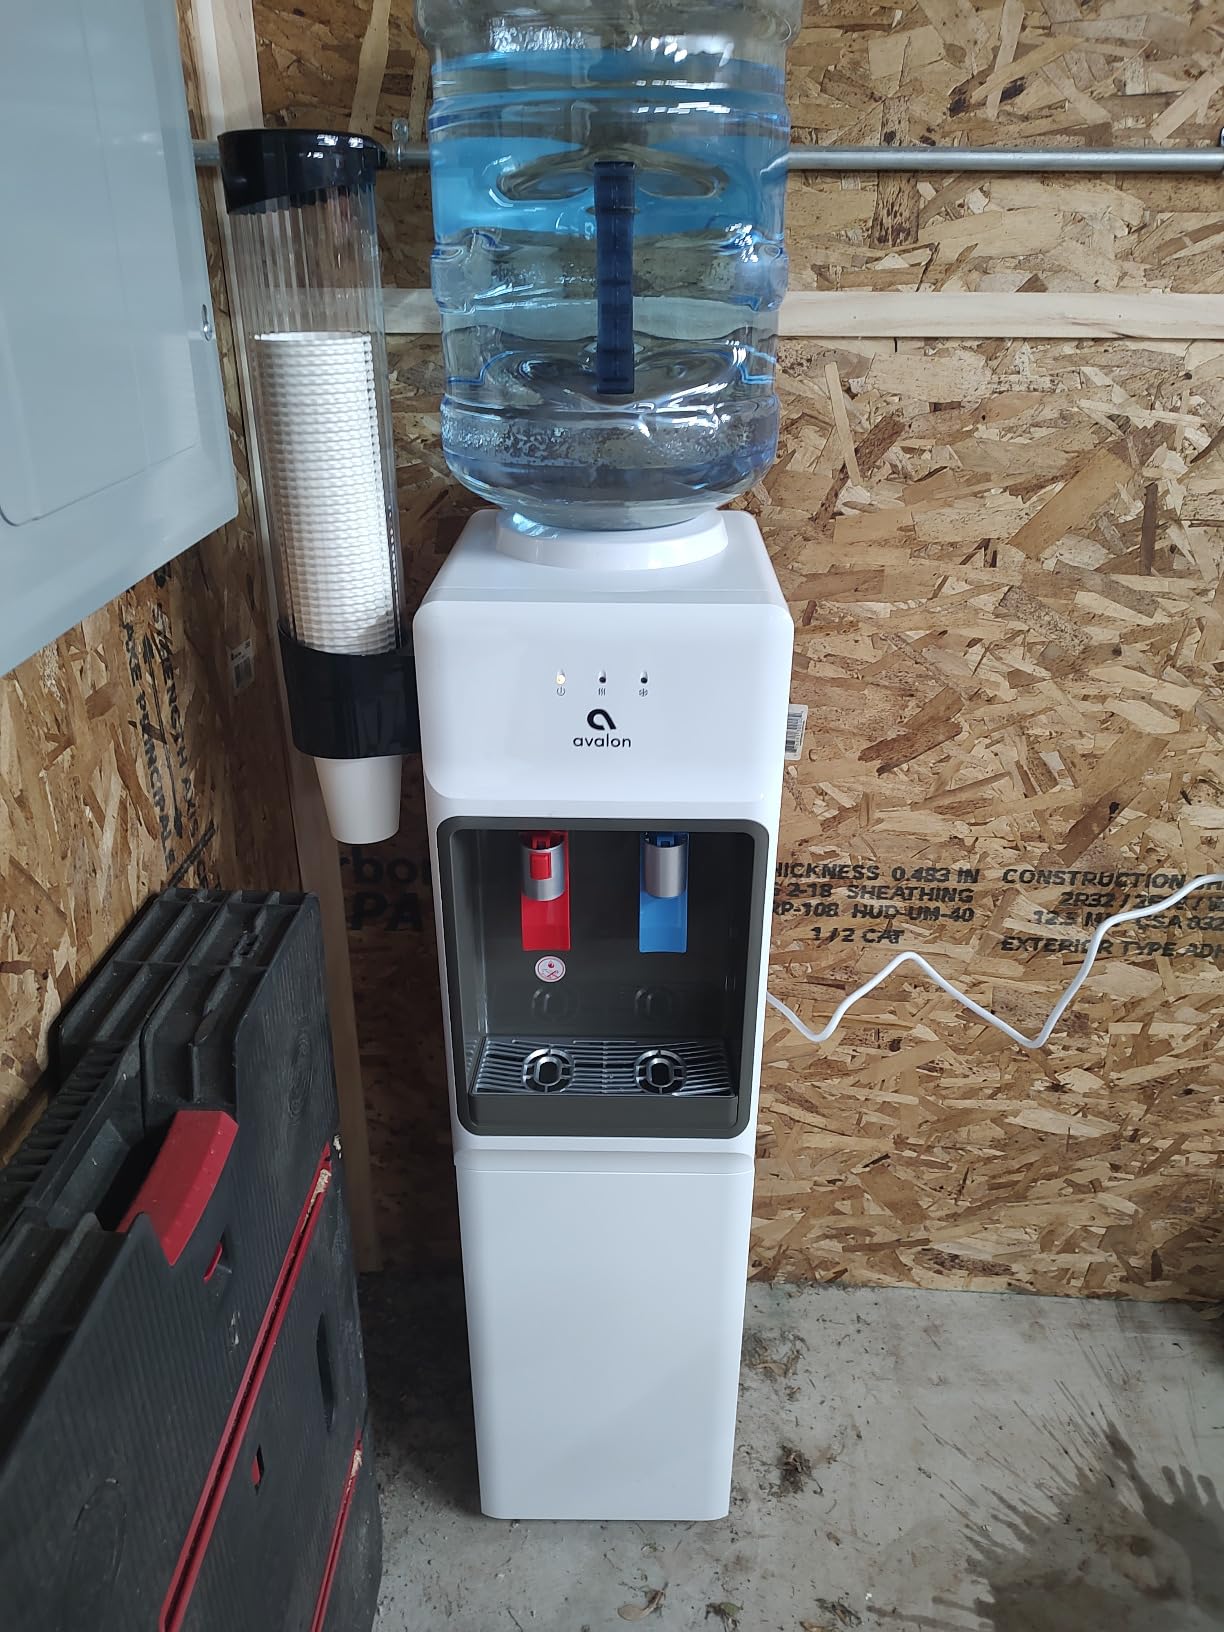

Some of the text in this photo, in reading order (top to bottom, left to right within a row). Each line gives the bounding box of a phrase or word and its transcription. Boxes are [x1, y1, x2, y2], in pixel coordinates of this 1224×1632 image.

[572, 732, 632, 748] avalon
[956, 867, 980, 883] IN
[1002, 868, 1187, 889] CONSTRUCTION
[847, 884, 976, 903] SHEATHING
[861, 928, 906, 944] CAT
